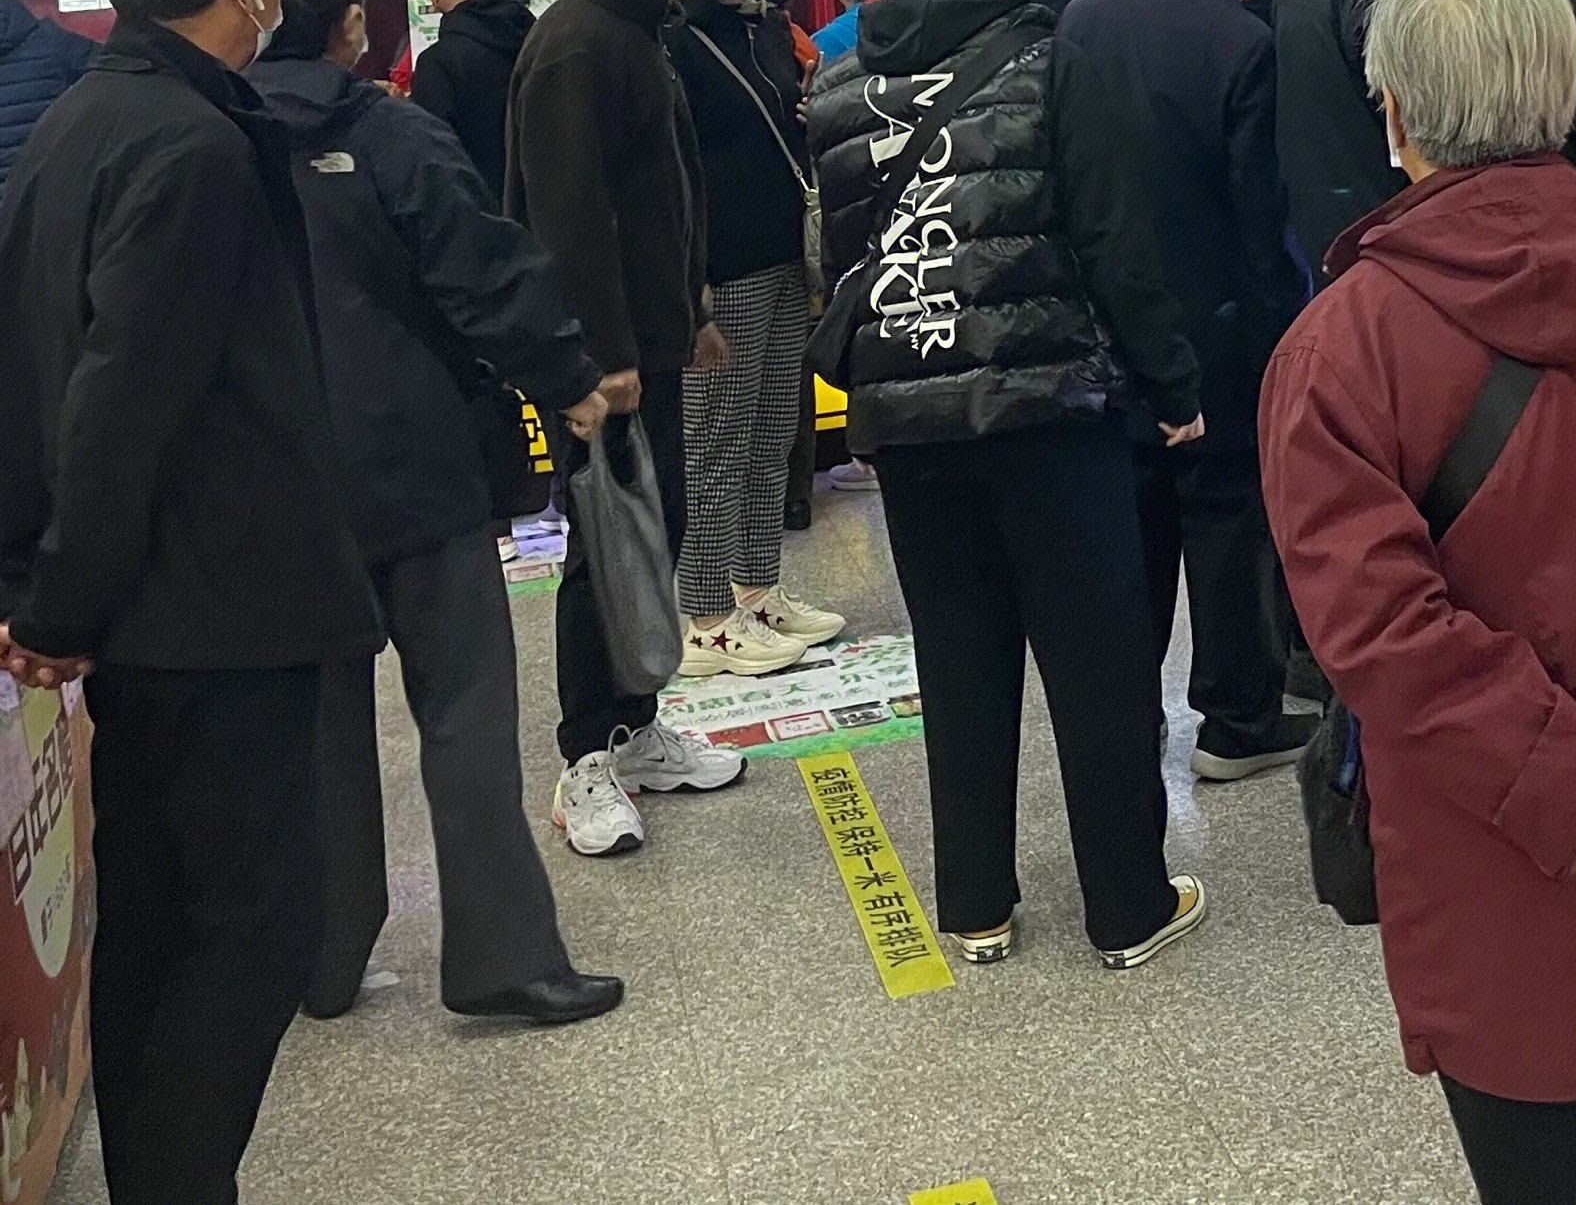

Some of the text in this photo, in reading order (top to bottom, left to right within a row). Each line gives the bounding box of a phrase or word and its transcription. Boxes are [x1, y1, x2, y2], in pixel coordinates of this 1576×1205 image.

[910, 72, 960, 360] MONCLER
[810, 767, 931, 969] 疫情防控 保持一米 有序排队
